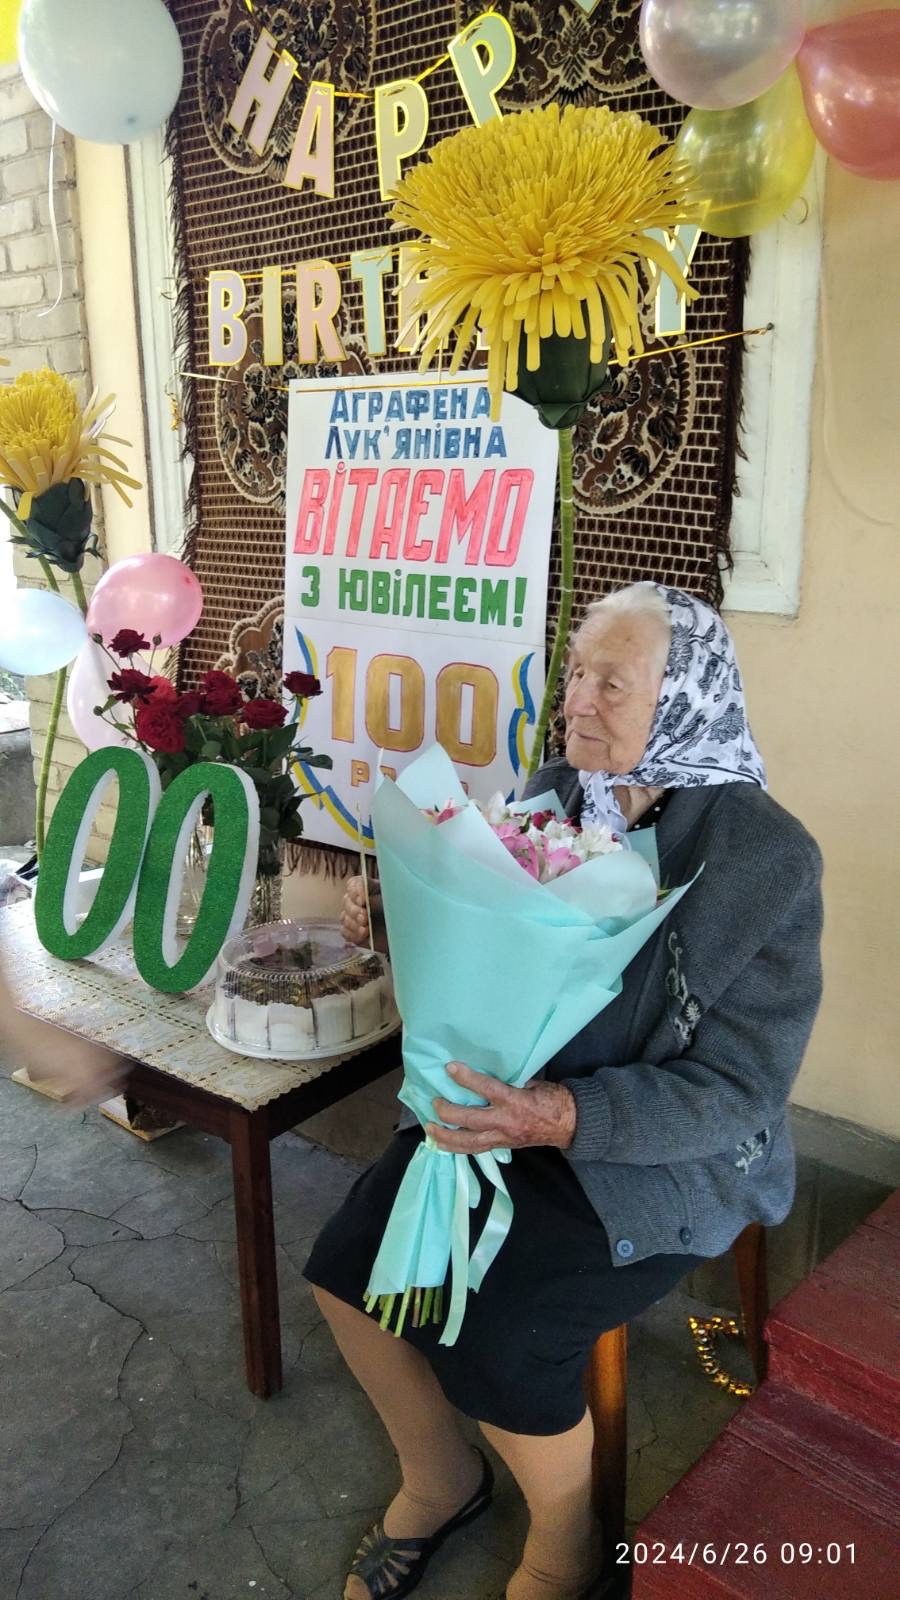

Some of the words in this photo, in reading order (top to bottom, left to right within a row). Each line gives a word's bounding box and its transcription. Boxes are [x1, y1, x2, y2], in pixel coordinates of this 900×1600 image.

[227, 2, 598, 201] HAPP
[329, 387, 492, 423] АГРАФЕНА
[300, 565, 321, 607] З
[326, 645, 499, 767] 100
